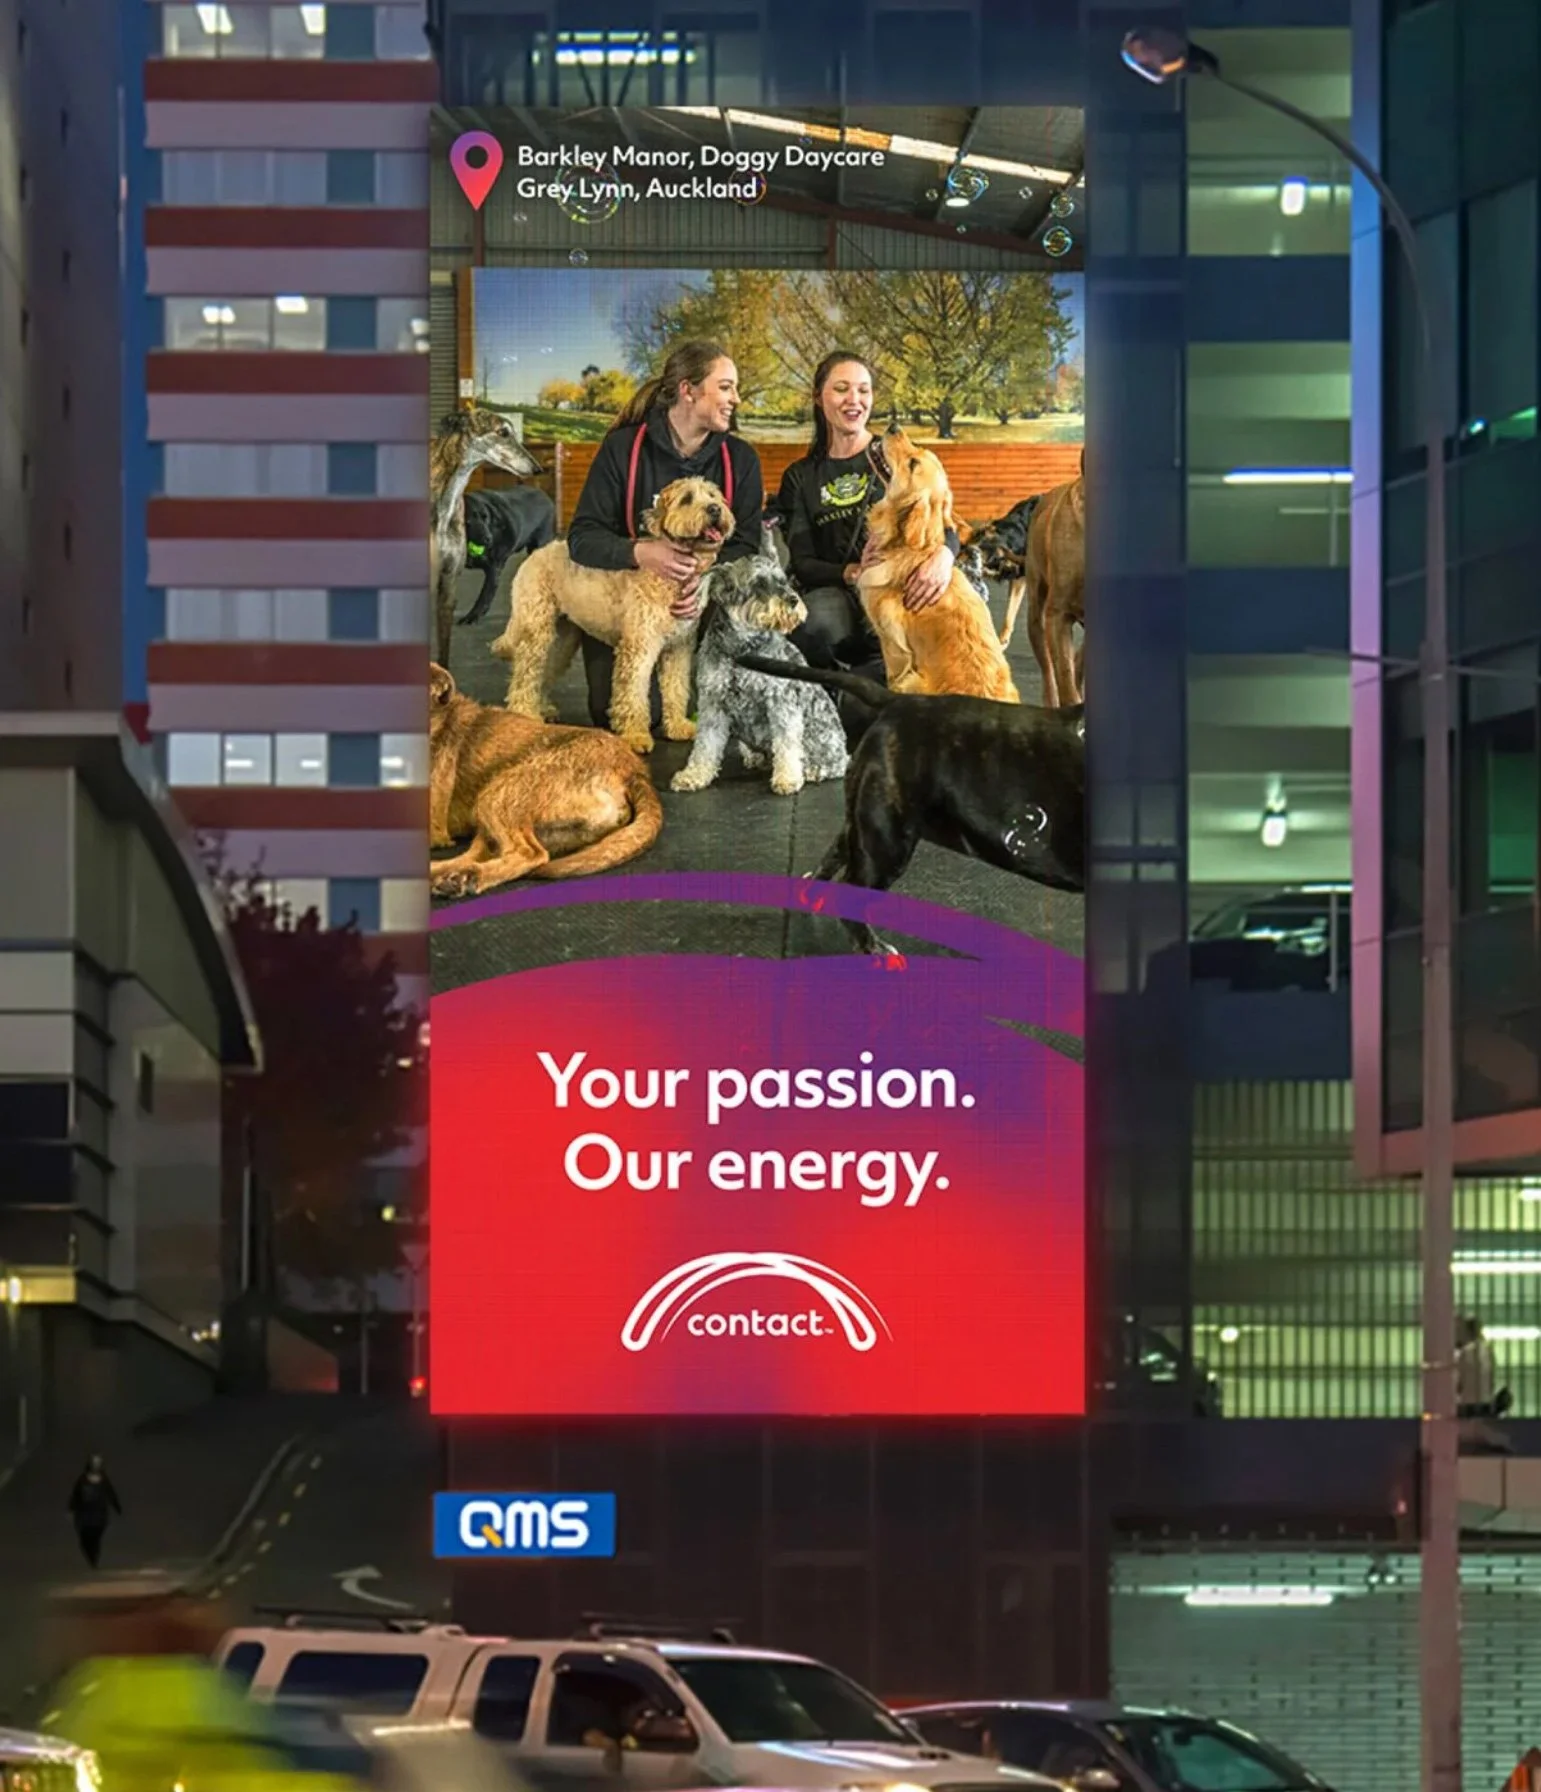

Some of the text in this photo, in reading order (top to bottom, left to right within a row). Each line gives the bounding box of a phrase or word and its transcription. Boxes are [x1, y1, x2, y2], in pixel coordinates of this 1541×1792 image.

[518, 145, 885, 172] Barkley Manor, Doggy Daycare
[517, 176, 757, 204] Grey Lynn, Auckland
[537, 1050, 976, 1126] Your passion.
[564, 1133, 950, 1208] Our energy.
[687, 1309, 824, 1337] contact
[459, 1500, 590, 1549] QMS
